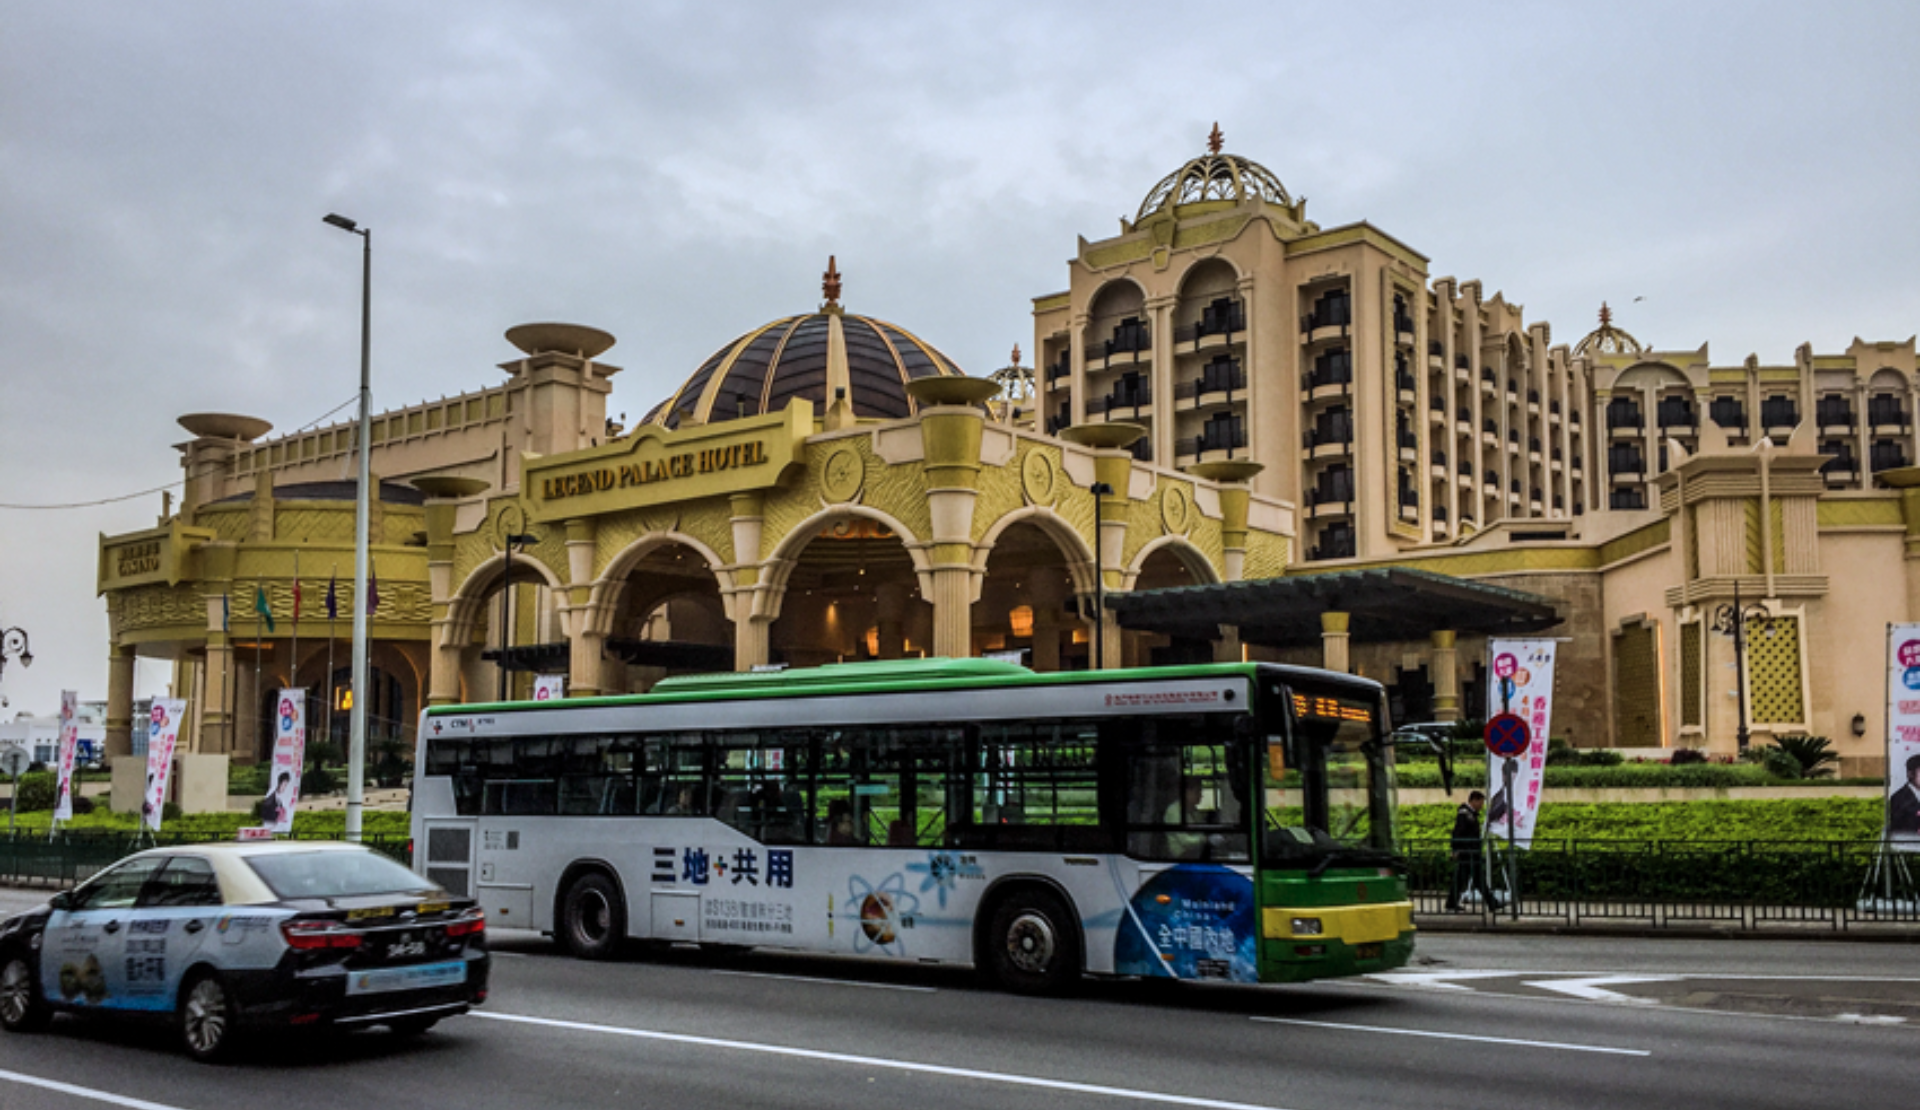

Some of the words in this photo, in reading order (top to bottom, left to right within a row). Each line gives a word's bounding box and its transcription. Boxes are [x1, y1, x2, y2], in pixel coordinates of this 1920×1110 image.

[542, 468, 615, 501] LEGEND
[617, 453, 694, 489] PALACE
[698, 441, 769, 475] HOTEL
